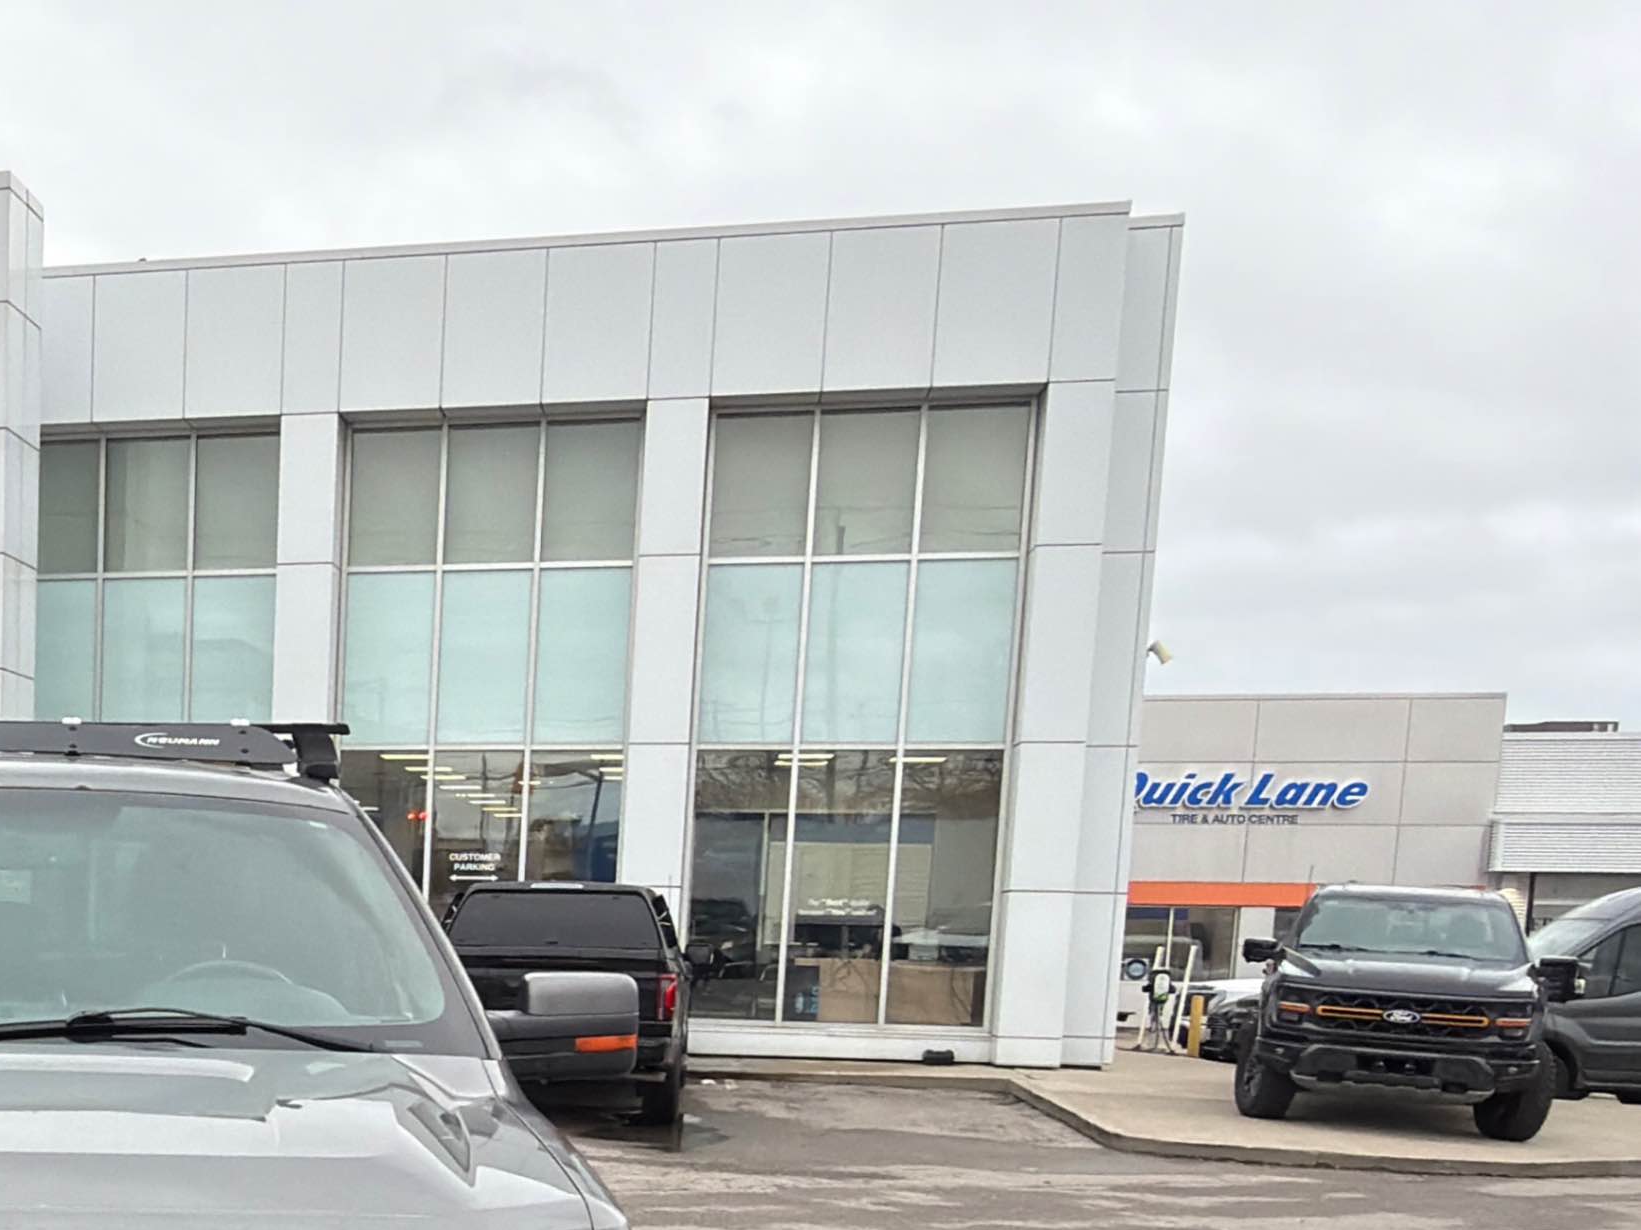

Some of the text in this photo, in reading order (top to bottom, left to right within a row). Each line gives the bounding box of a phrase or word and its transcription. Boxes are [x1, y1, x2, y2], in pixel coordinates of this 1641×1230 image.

[1244, 773, 1369, 806] Lane
[1171, 814, 1299, 825] TIRE & AUTO CENTRE
[449, 853, 501, 861] CUSTOMER
[453, 863, 496, 871] PARKING
